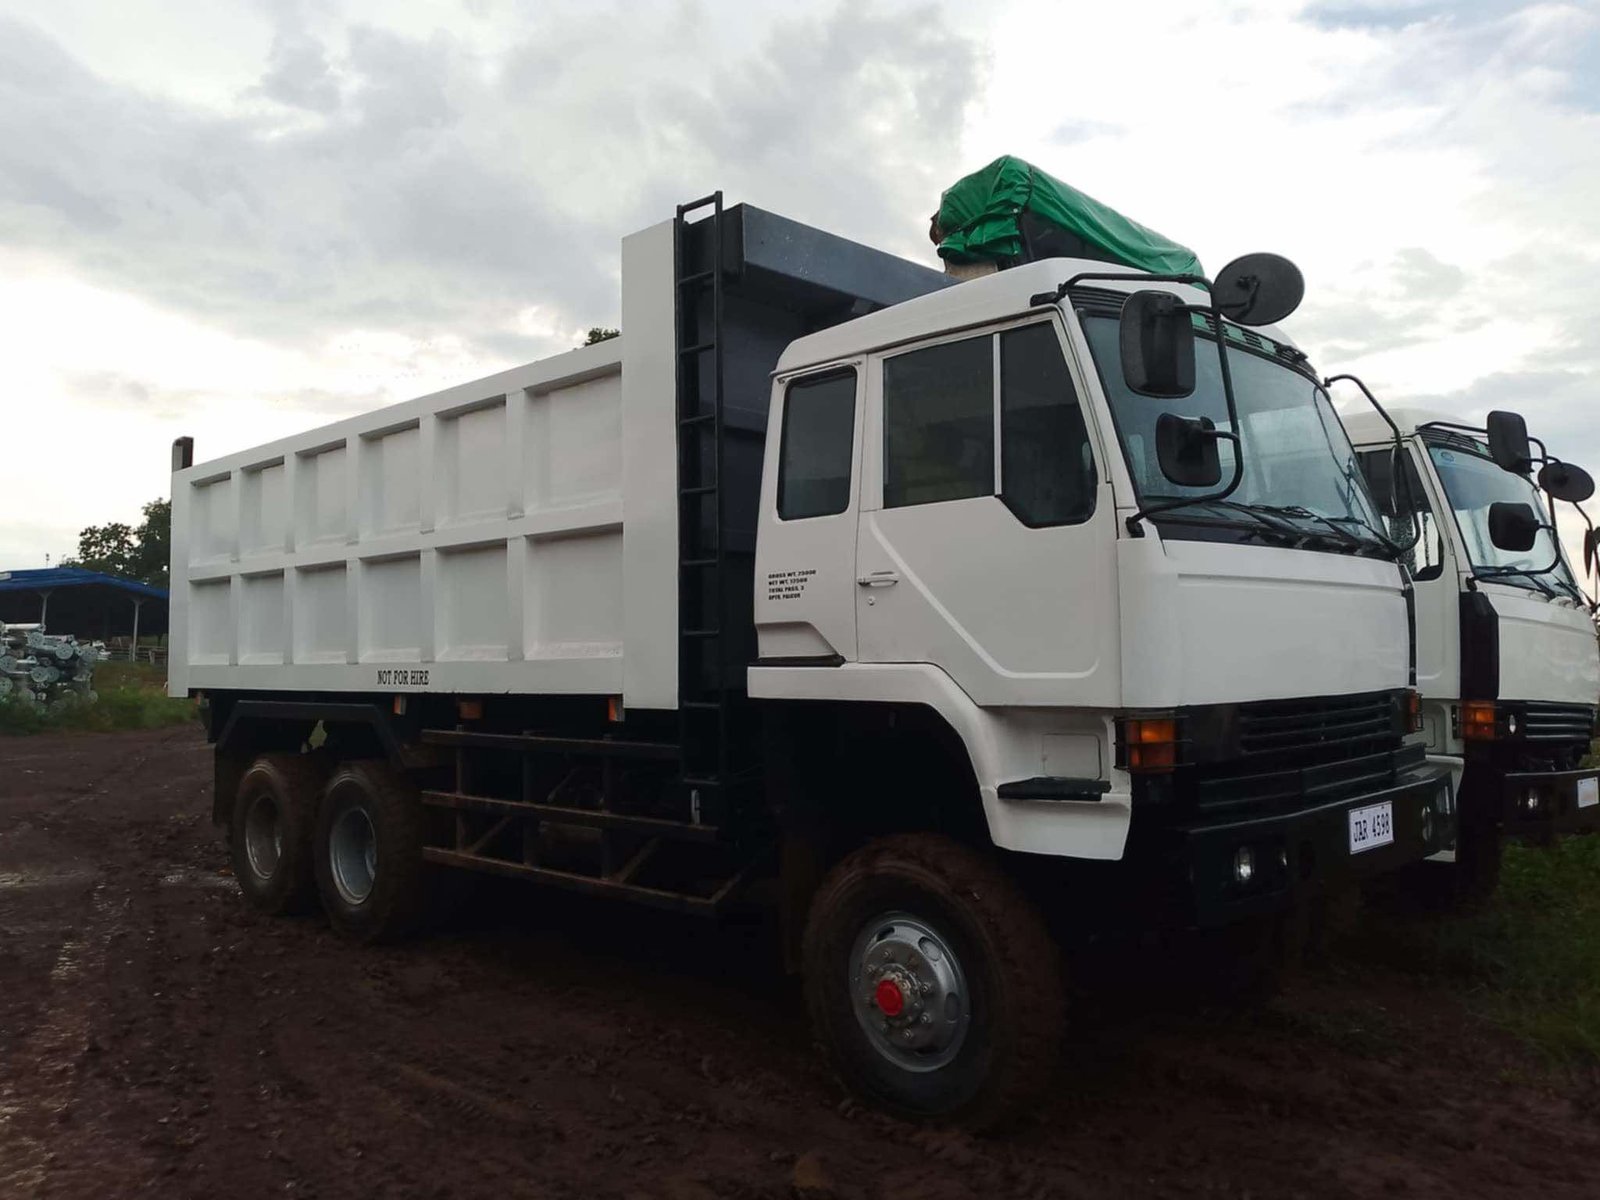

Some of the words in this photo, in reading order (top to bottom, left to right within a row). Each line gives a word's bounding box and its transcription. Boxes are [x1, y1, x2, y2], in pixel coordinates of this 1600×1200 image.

[376, 670, 391, 685] NOT
[393, 670, 409, 685] FOR
[410, 670, 430, 686] HIRE
[1372, 812, 1390, 838] 4598
